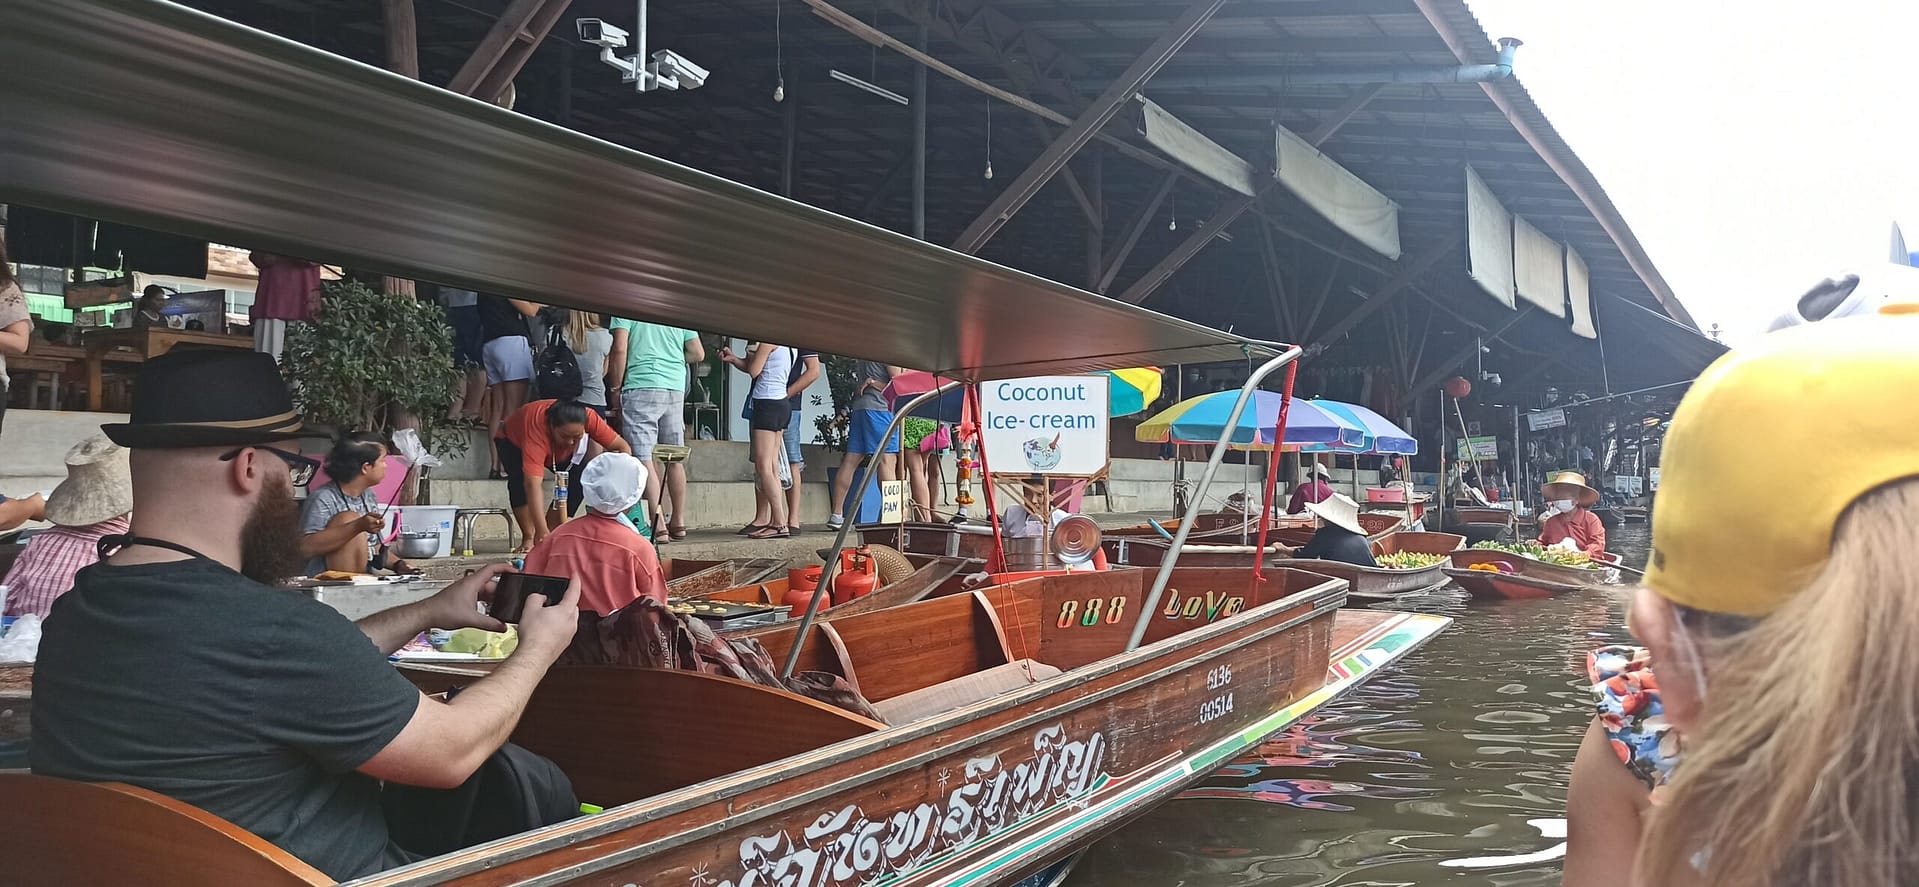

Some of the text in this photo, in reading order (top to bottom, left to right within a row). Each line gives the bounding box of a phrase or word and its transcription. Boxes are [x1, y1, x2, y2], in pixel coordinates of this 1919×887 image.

[998, 382, 1086, 401] Coconut
[883, 484, 900, 497] COCO
[883, 501, 898, 514] PAN
[1056, 596, 1127, 629] 888
[1207, 663, 1232, 691] 6136
[1200, 692, 1234, 724] 00514
